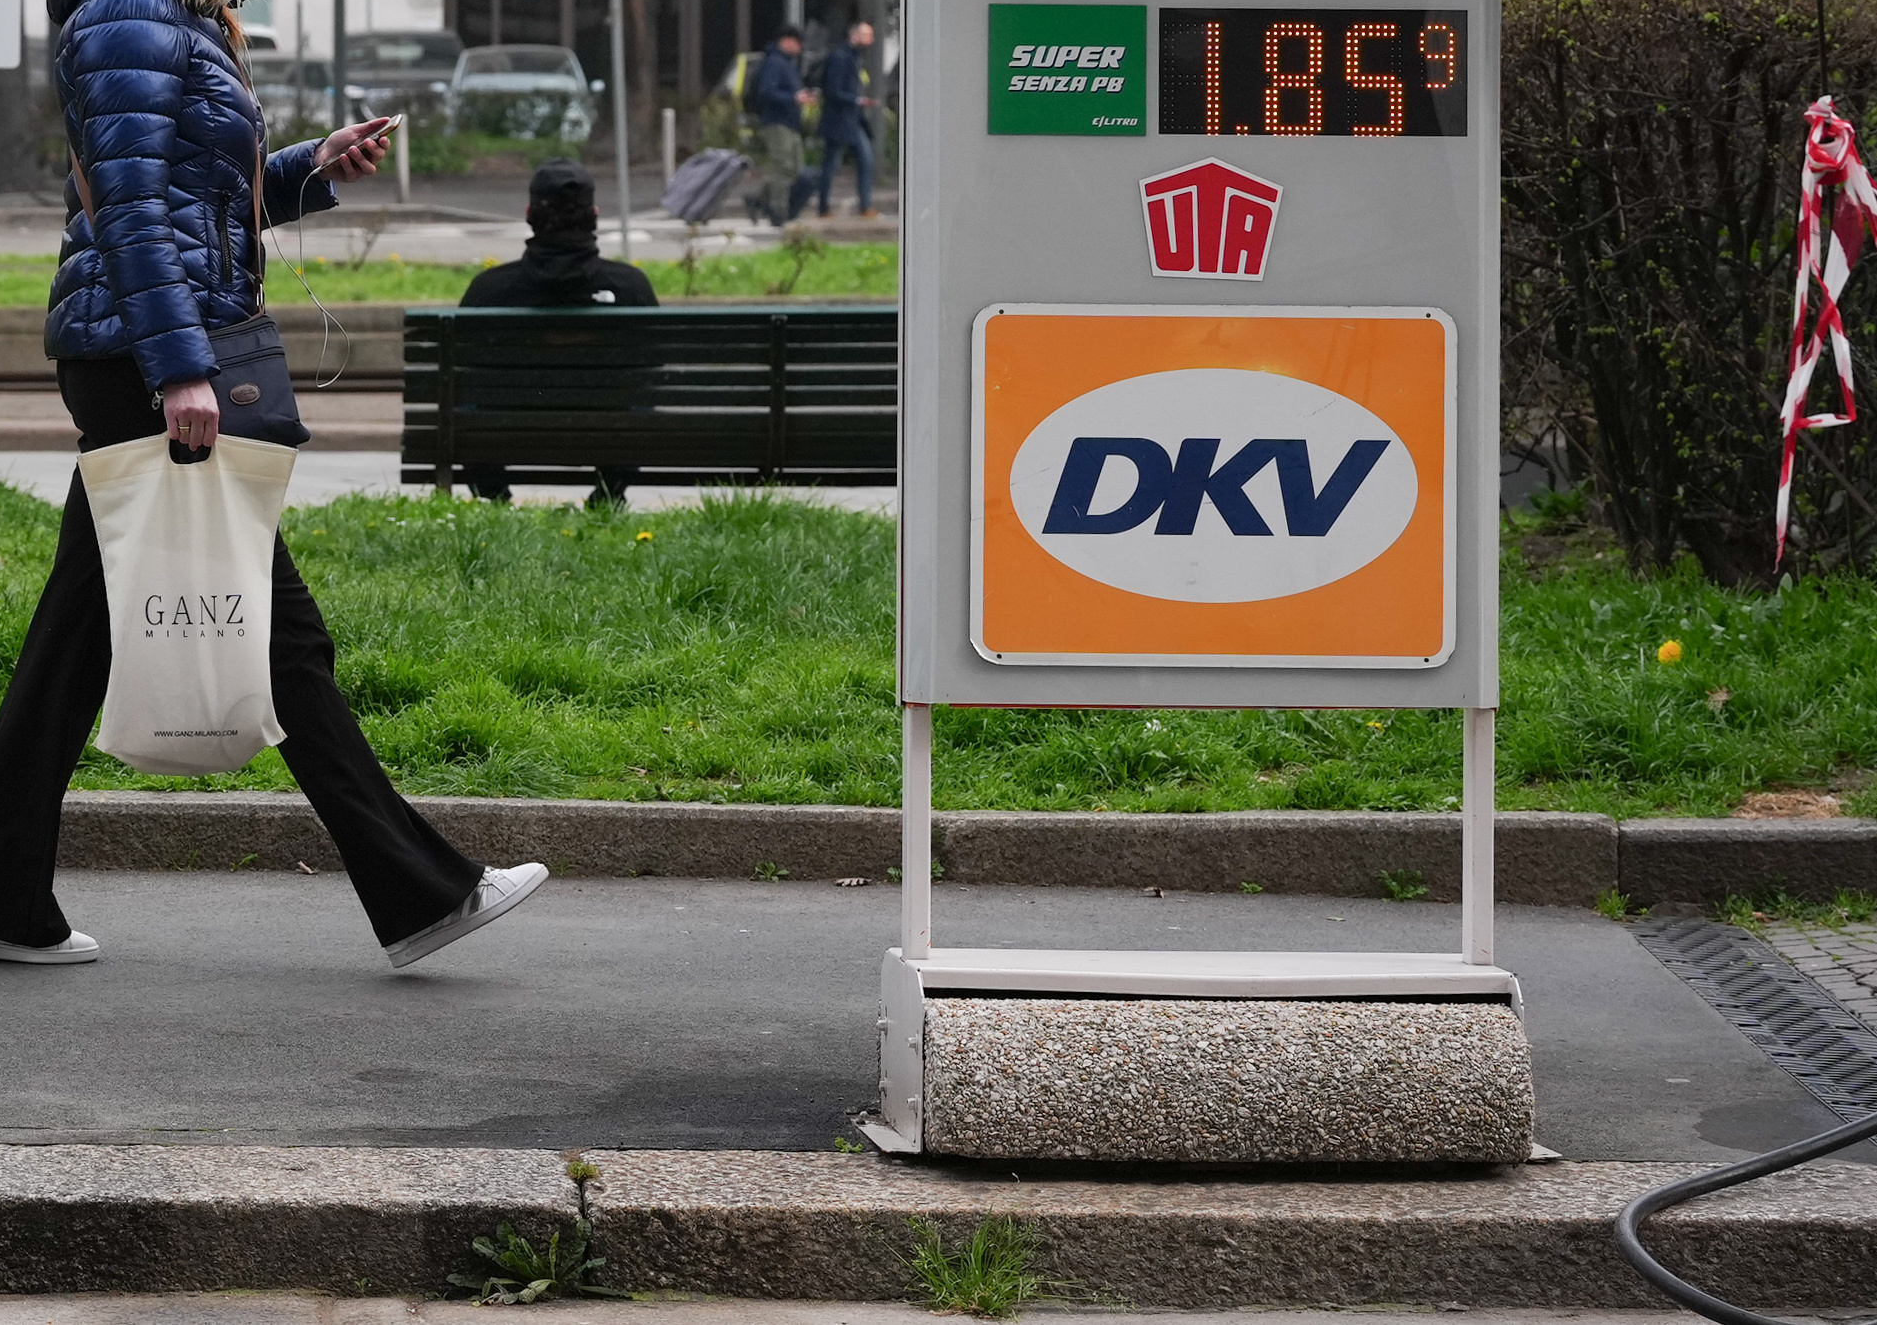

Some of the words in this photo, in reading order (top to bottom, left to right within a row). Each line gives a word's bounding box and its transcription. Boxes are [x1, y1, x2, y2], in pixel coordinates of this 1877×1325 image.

[1008, 45, 1126, 69] SUPER
[1008, 75, 1085, 92] SENZA
[1090, 76, 1124, 93] PB
[1144, 162, 1279, 276] UTA
[1041, 437, 1391, 537] DKV
[145, 594, 244, 625] GANZ
[145, 629, 245, 637] MILANO
